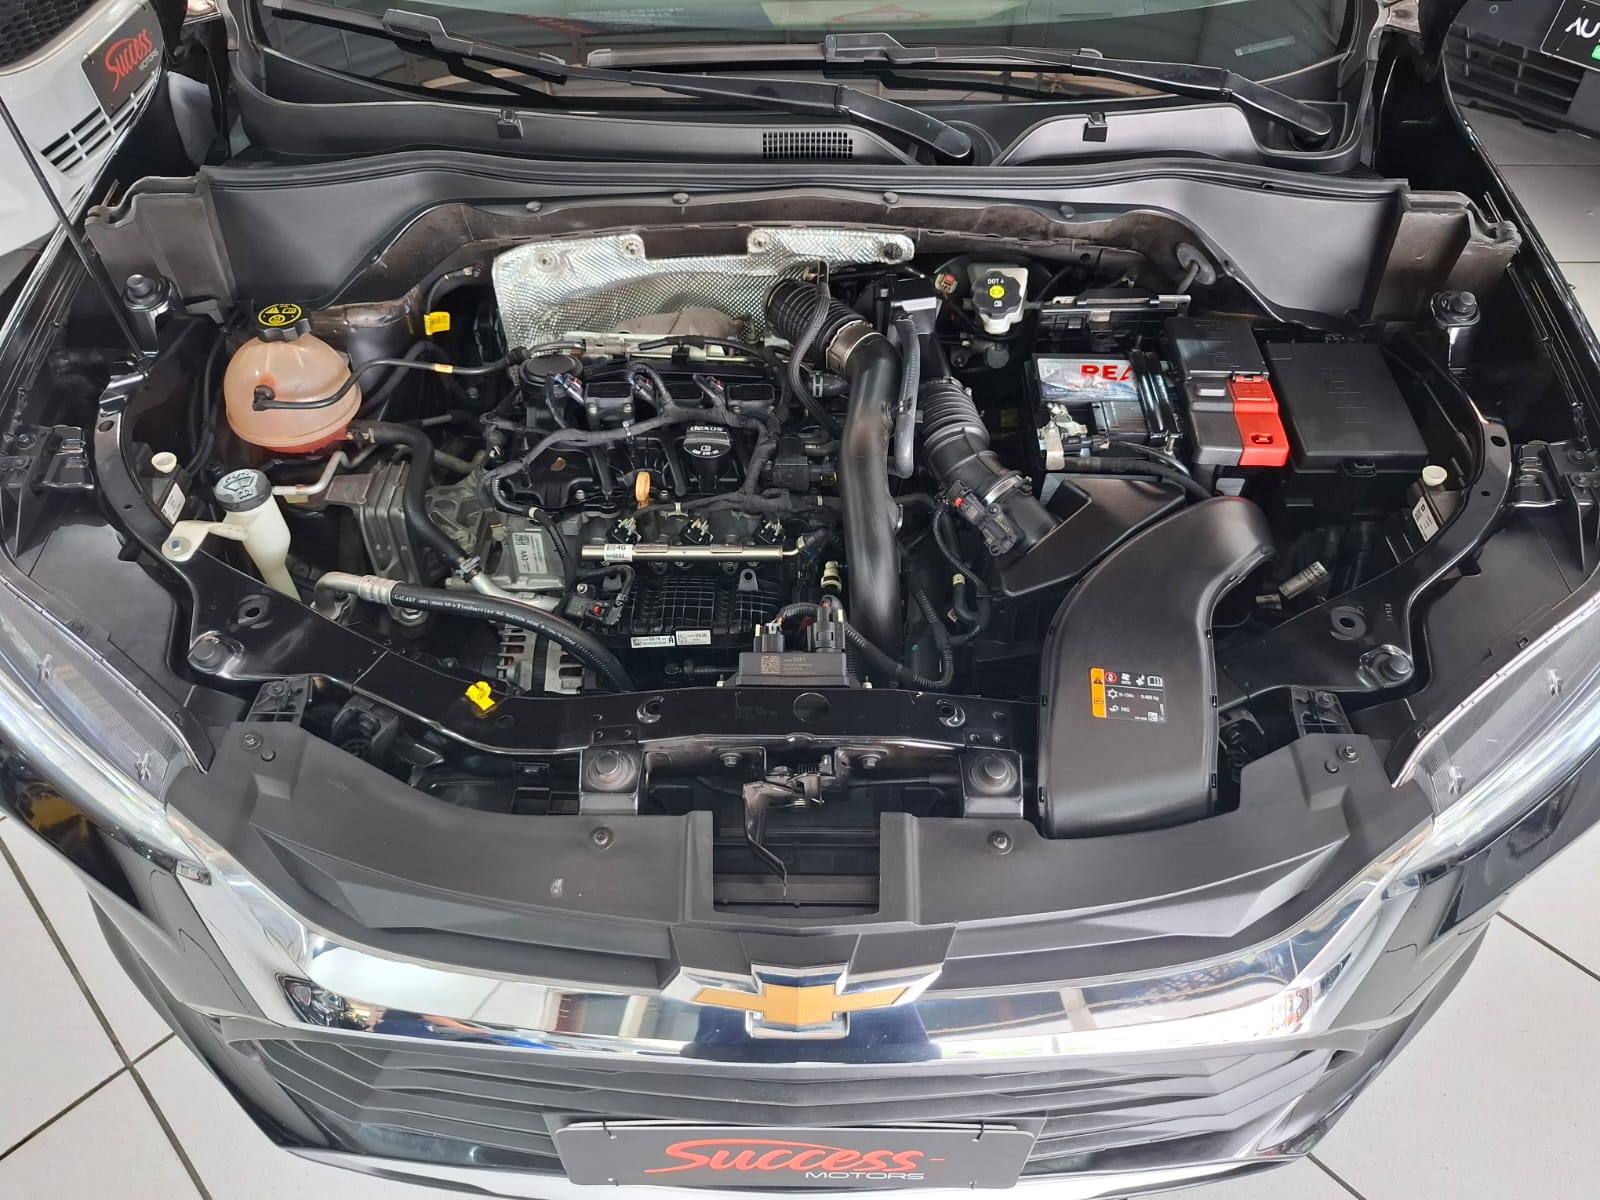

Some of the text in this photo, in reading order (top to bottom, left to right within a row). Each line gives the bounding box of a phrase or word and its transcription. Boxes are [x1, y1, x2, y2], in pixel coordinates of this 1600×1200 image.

[104, 28, 153, 93] Success
[644, 1138, 924, 1173] Success
[805, 1171, 925, 1180] MOTORS
